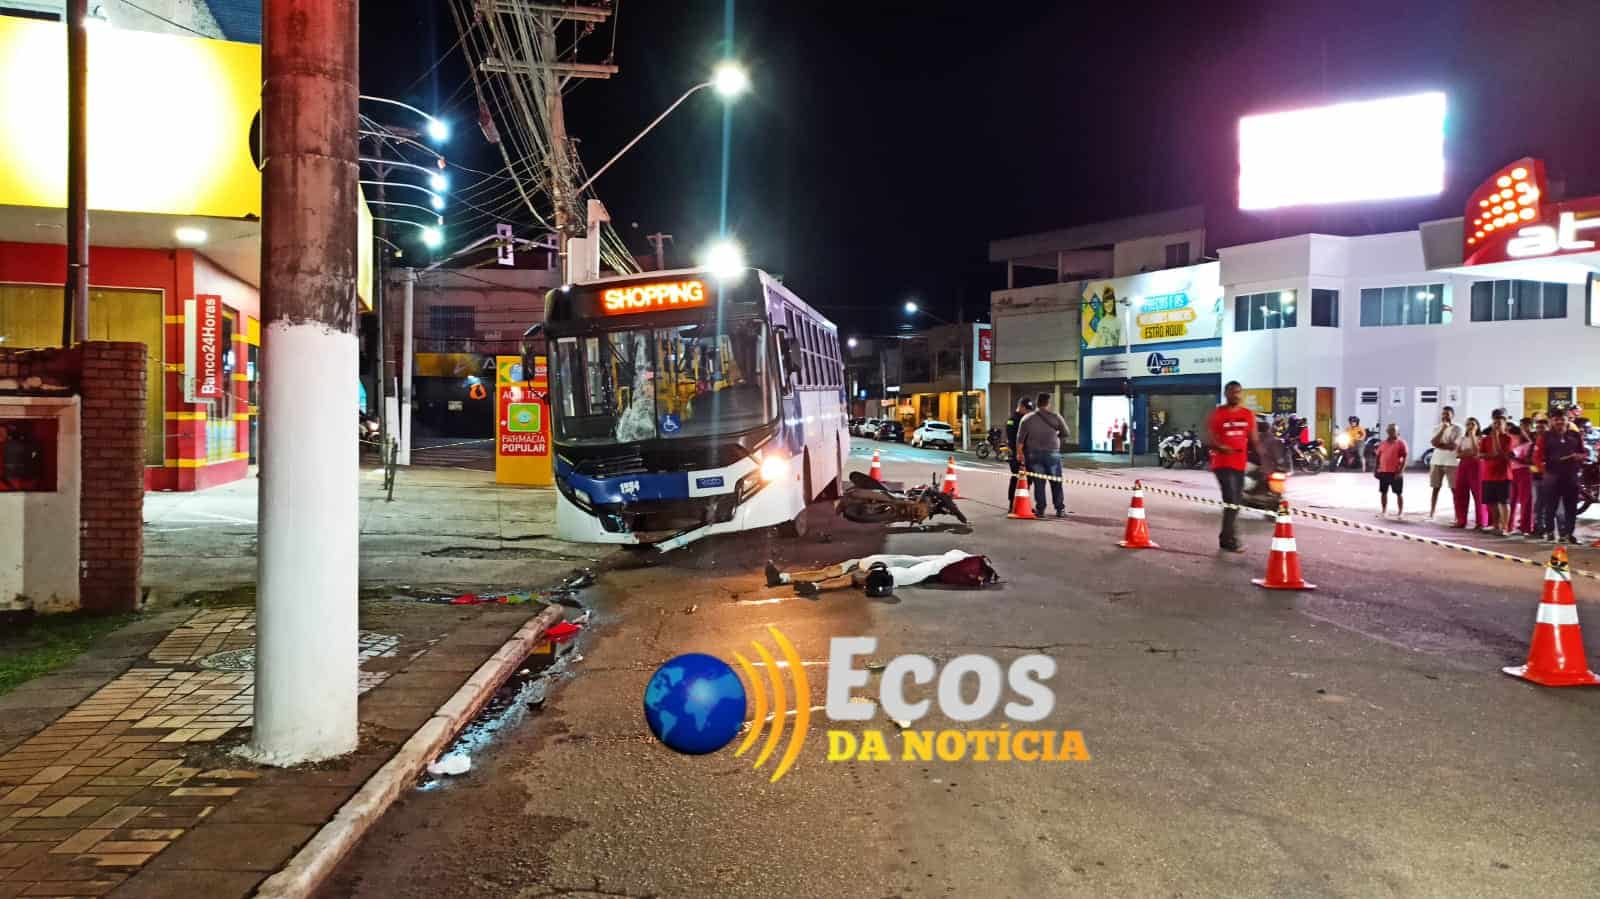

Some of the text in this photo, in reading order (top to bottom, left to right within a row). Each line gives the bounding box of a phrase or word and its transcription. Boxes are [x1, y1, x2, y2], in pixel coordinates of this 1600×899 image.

[604, 280, 704, 311] SHOPPING
[201, 298, 216, 394] Banco24Horas
[503, 391, 525, 400] AQI
[502, 444, 546, 453] POPULAR
